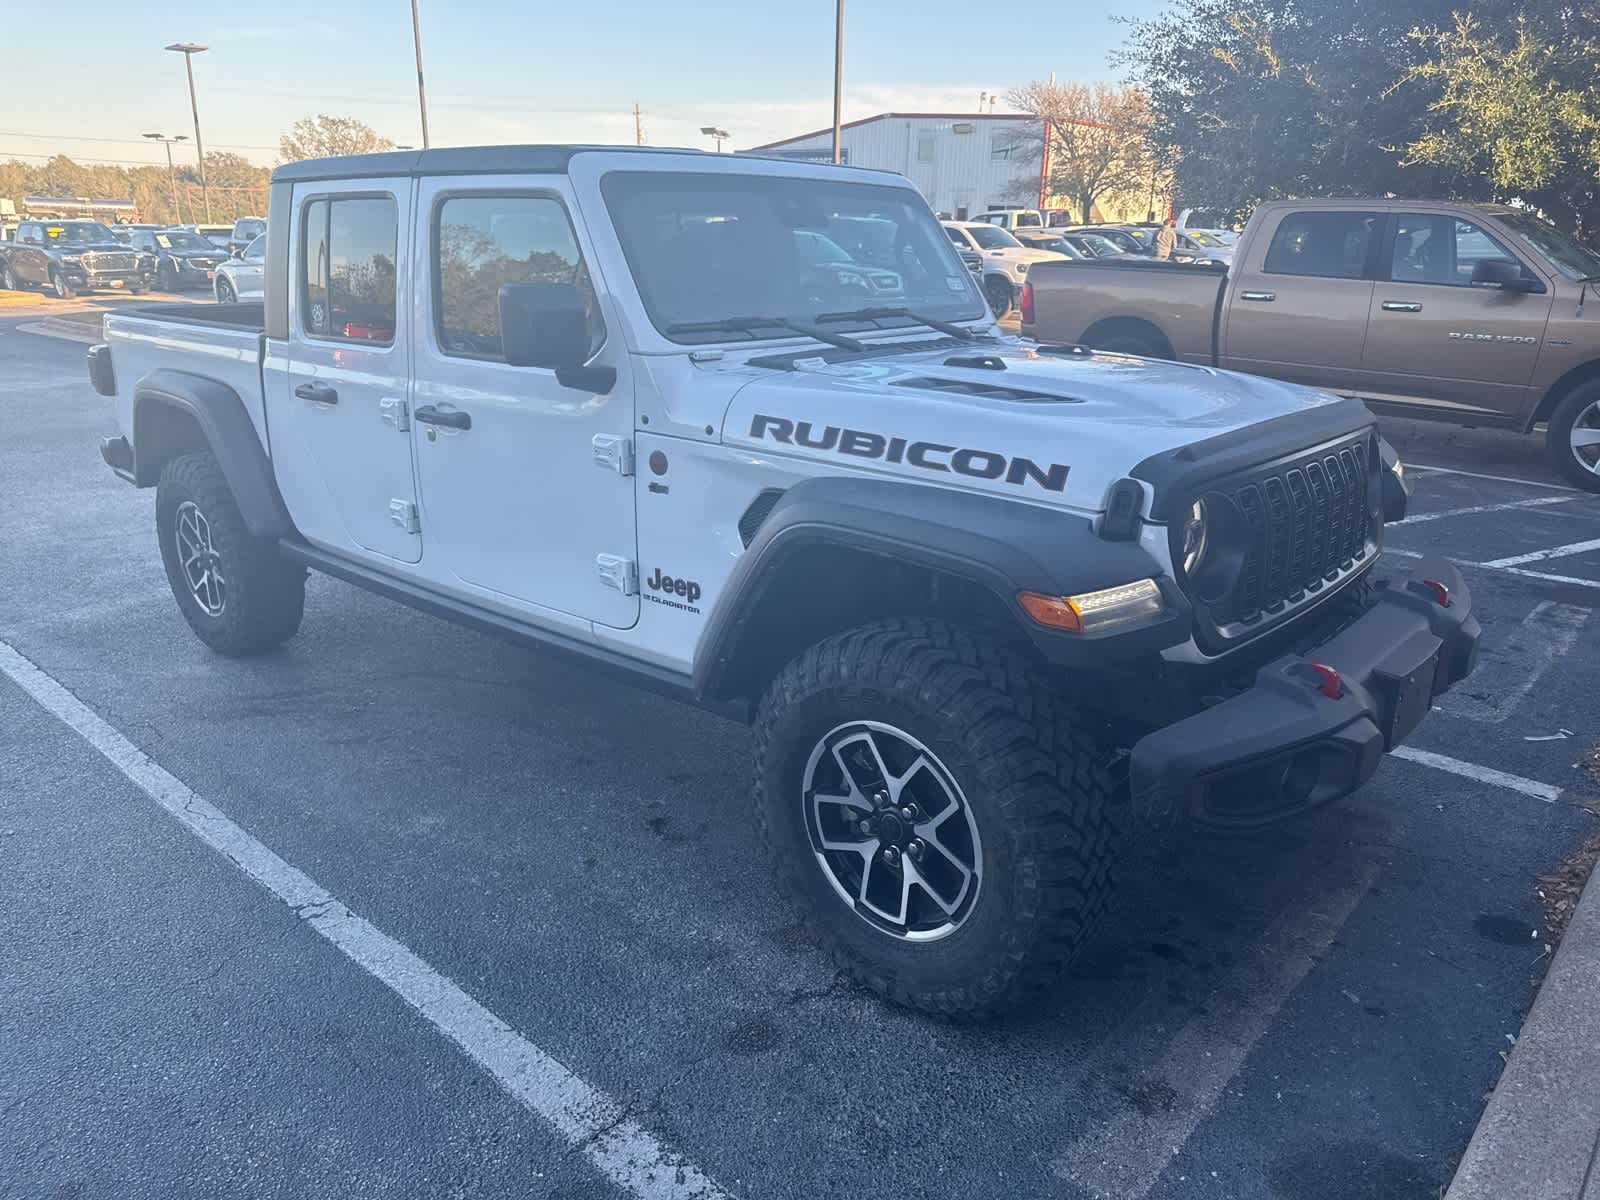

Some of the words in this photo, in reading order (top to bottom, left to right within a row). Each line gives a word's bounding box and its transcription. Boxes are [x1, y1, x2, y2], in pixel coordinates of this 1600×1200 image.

[1447, 332, 1493, 342] RAM
[1495, 335, 1537, 345] 1500
[750, 414, 1072, 493] RUBICON
[647, 567, 701, 604] Jeep
[651, 595, 701, 615] GLADIATOR
